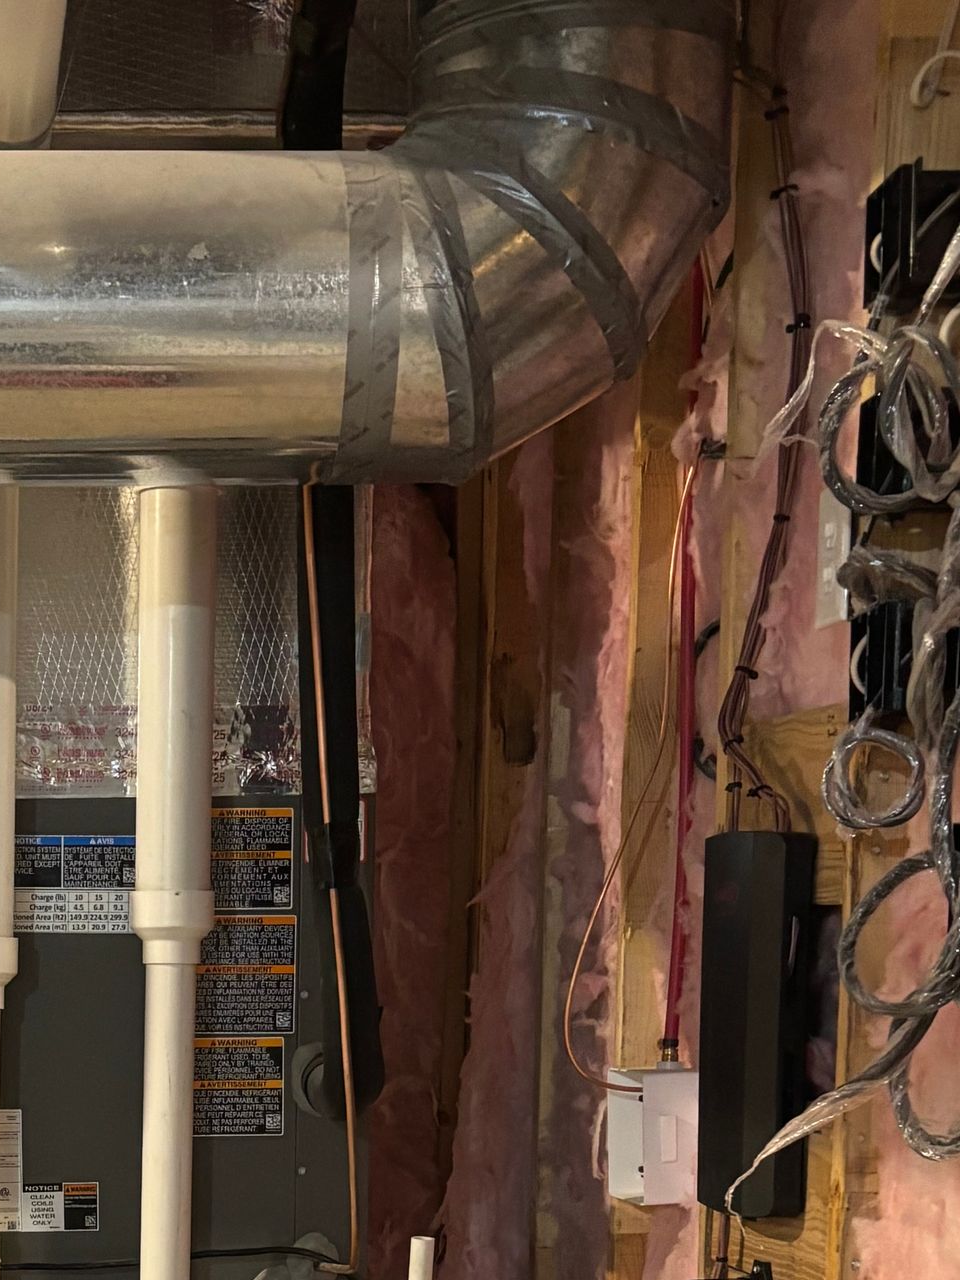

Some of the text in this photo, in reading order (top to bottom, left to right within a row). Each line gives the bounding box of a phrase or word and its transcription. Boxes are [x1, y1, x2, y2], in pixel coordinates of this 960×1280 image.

[225, 809, 266, 817] WARNING
[31, 894, 54, 902] Charge
[29, 904, 67, 912] Charge (kg)
